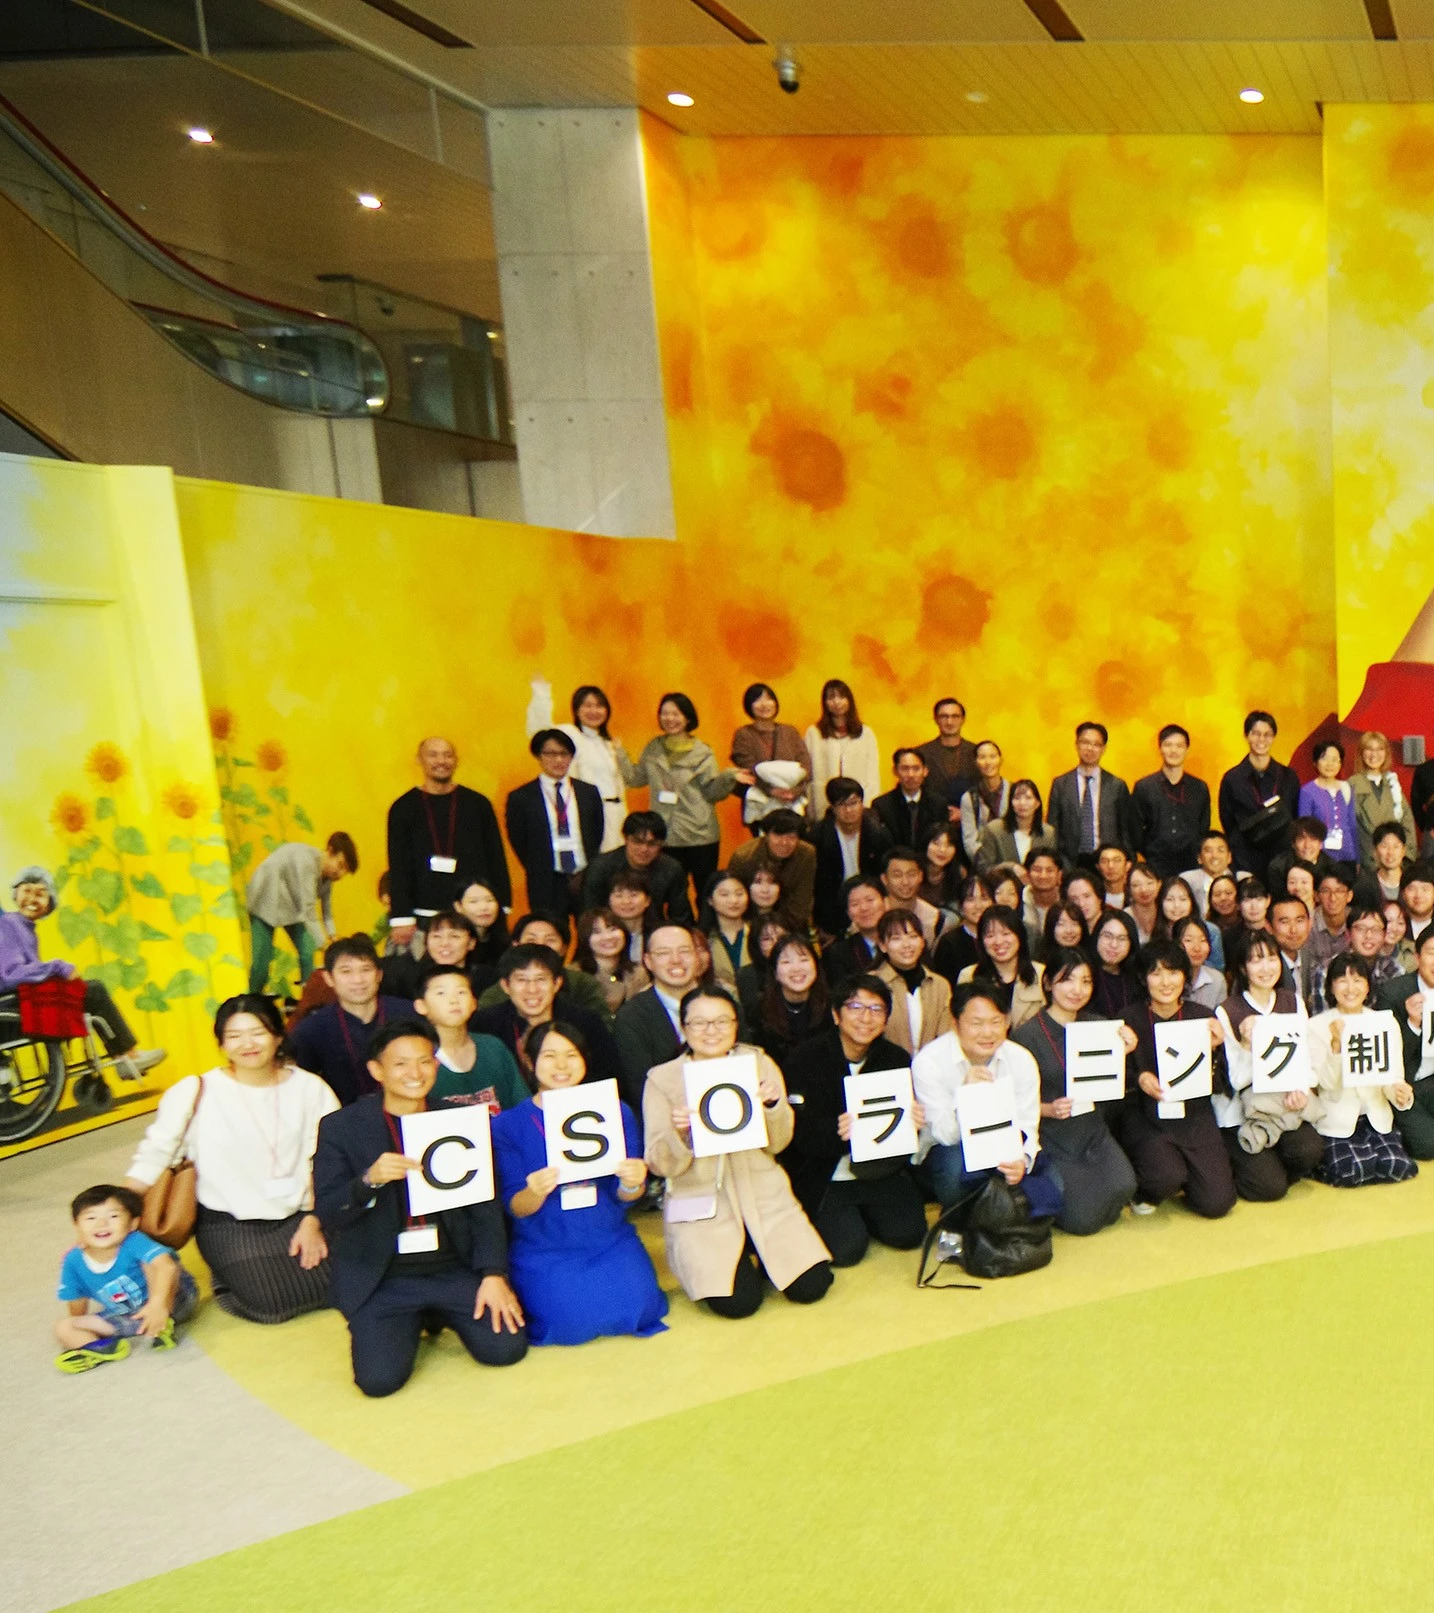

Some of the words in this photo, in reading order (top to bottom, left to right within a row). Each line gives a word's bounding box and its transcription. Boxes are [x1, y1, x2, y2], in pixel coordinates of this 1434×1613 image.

[1165, 1046, 1206, 1088] ン
[1260, 1032, 1301, 1079] グ
[1347, 1030, 1390, 1075] 制
[698, 1082, 753, 1135] O
[857, 1095, 905, 1144] ラ
[562, 1110, 609, 1162] S
[420, 1135, 478, 1190] C
